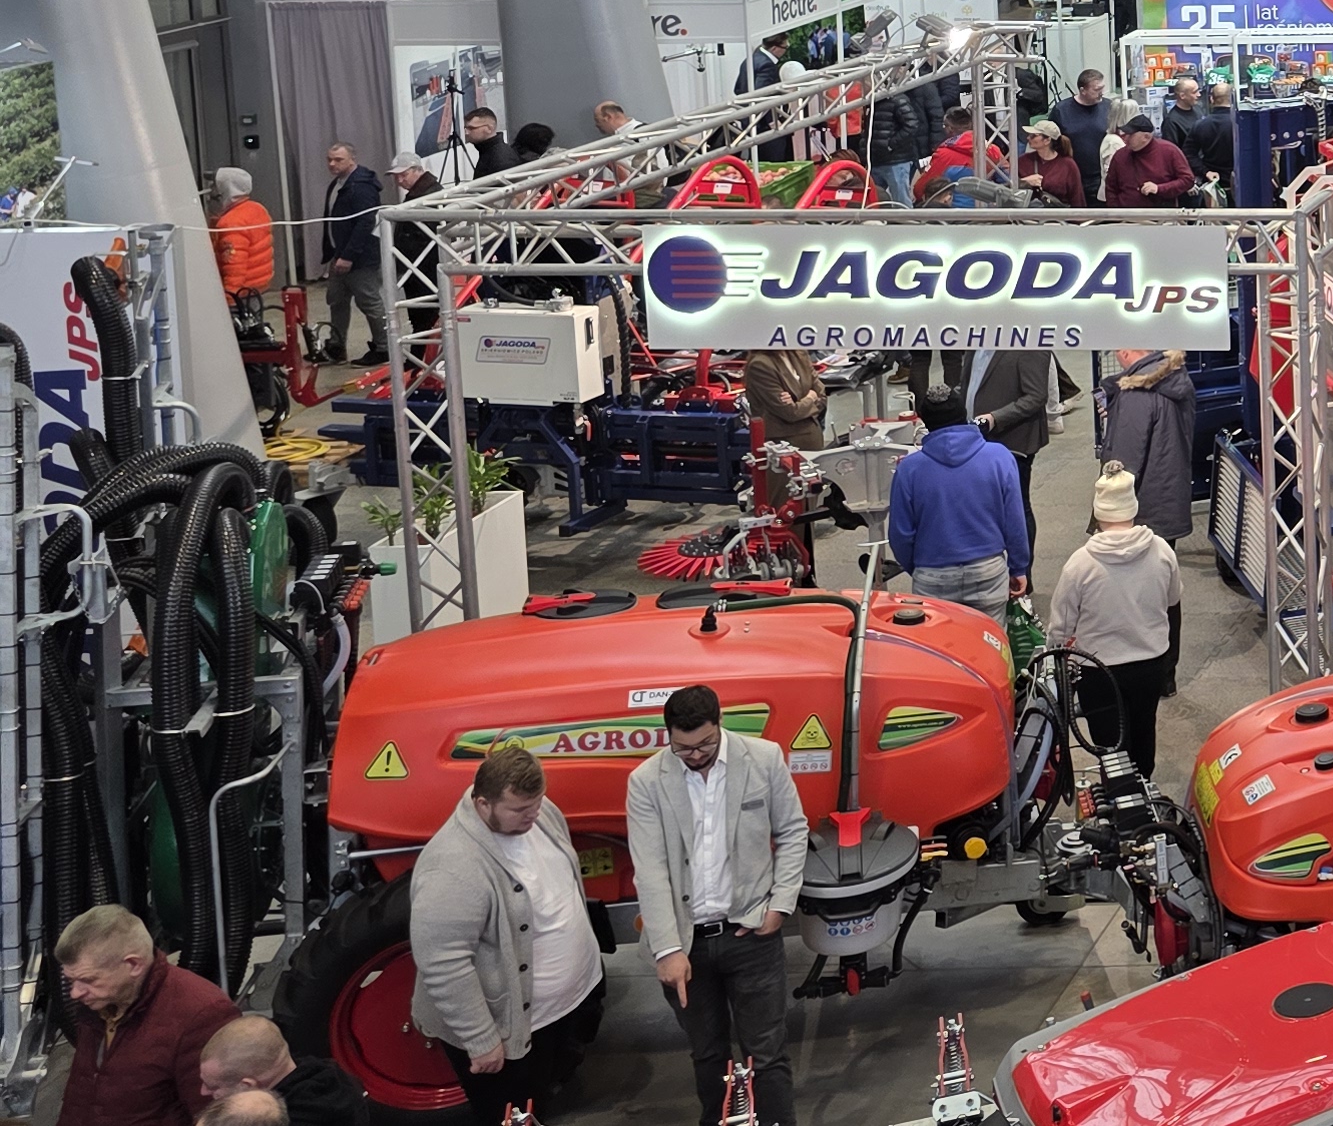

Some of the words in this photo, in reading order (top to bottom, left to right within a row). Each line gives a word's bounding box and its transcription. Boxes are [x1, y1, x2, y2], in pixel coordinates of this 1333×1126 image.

[1257, 4, 1279, 20] lat
[759, 250, 1134, 299] JAGODA
[1123, 284, 1222, 315] JPS
[62, 281, 101, 381] JPS
[496, 338, 537, 349] JAGODA
[768, 325, 1083, 348] AGROMACHINES
[550, 726, 665, 755] AGROL
